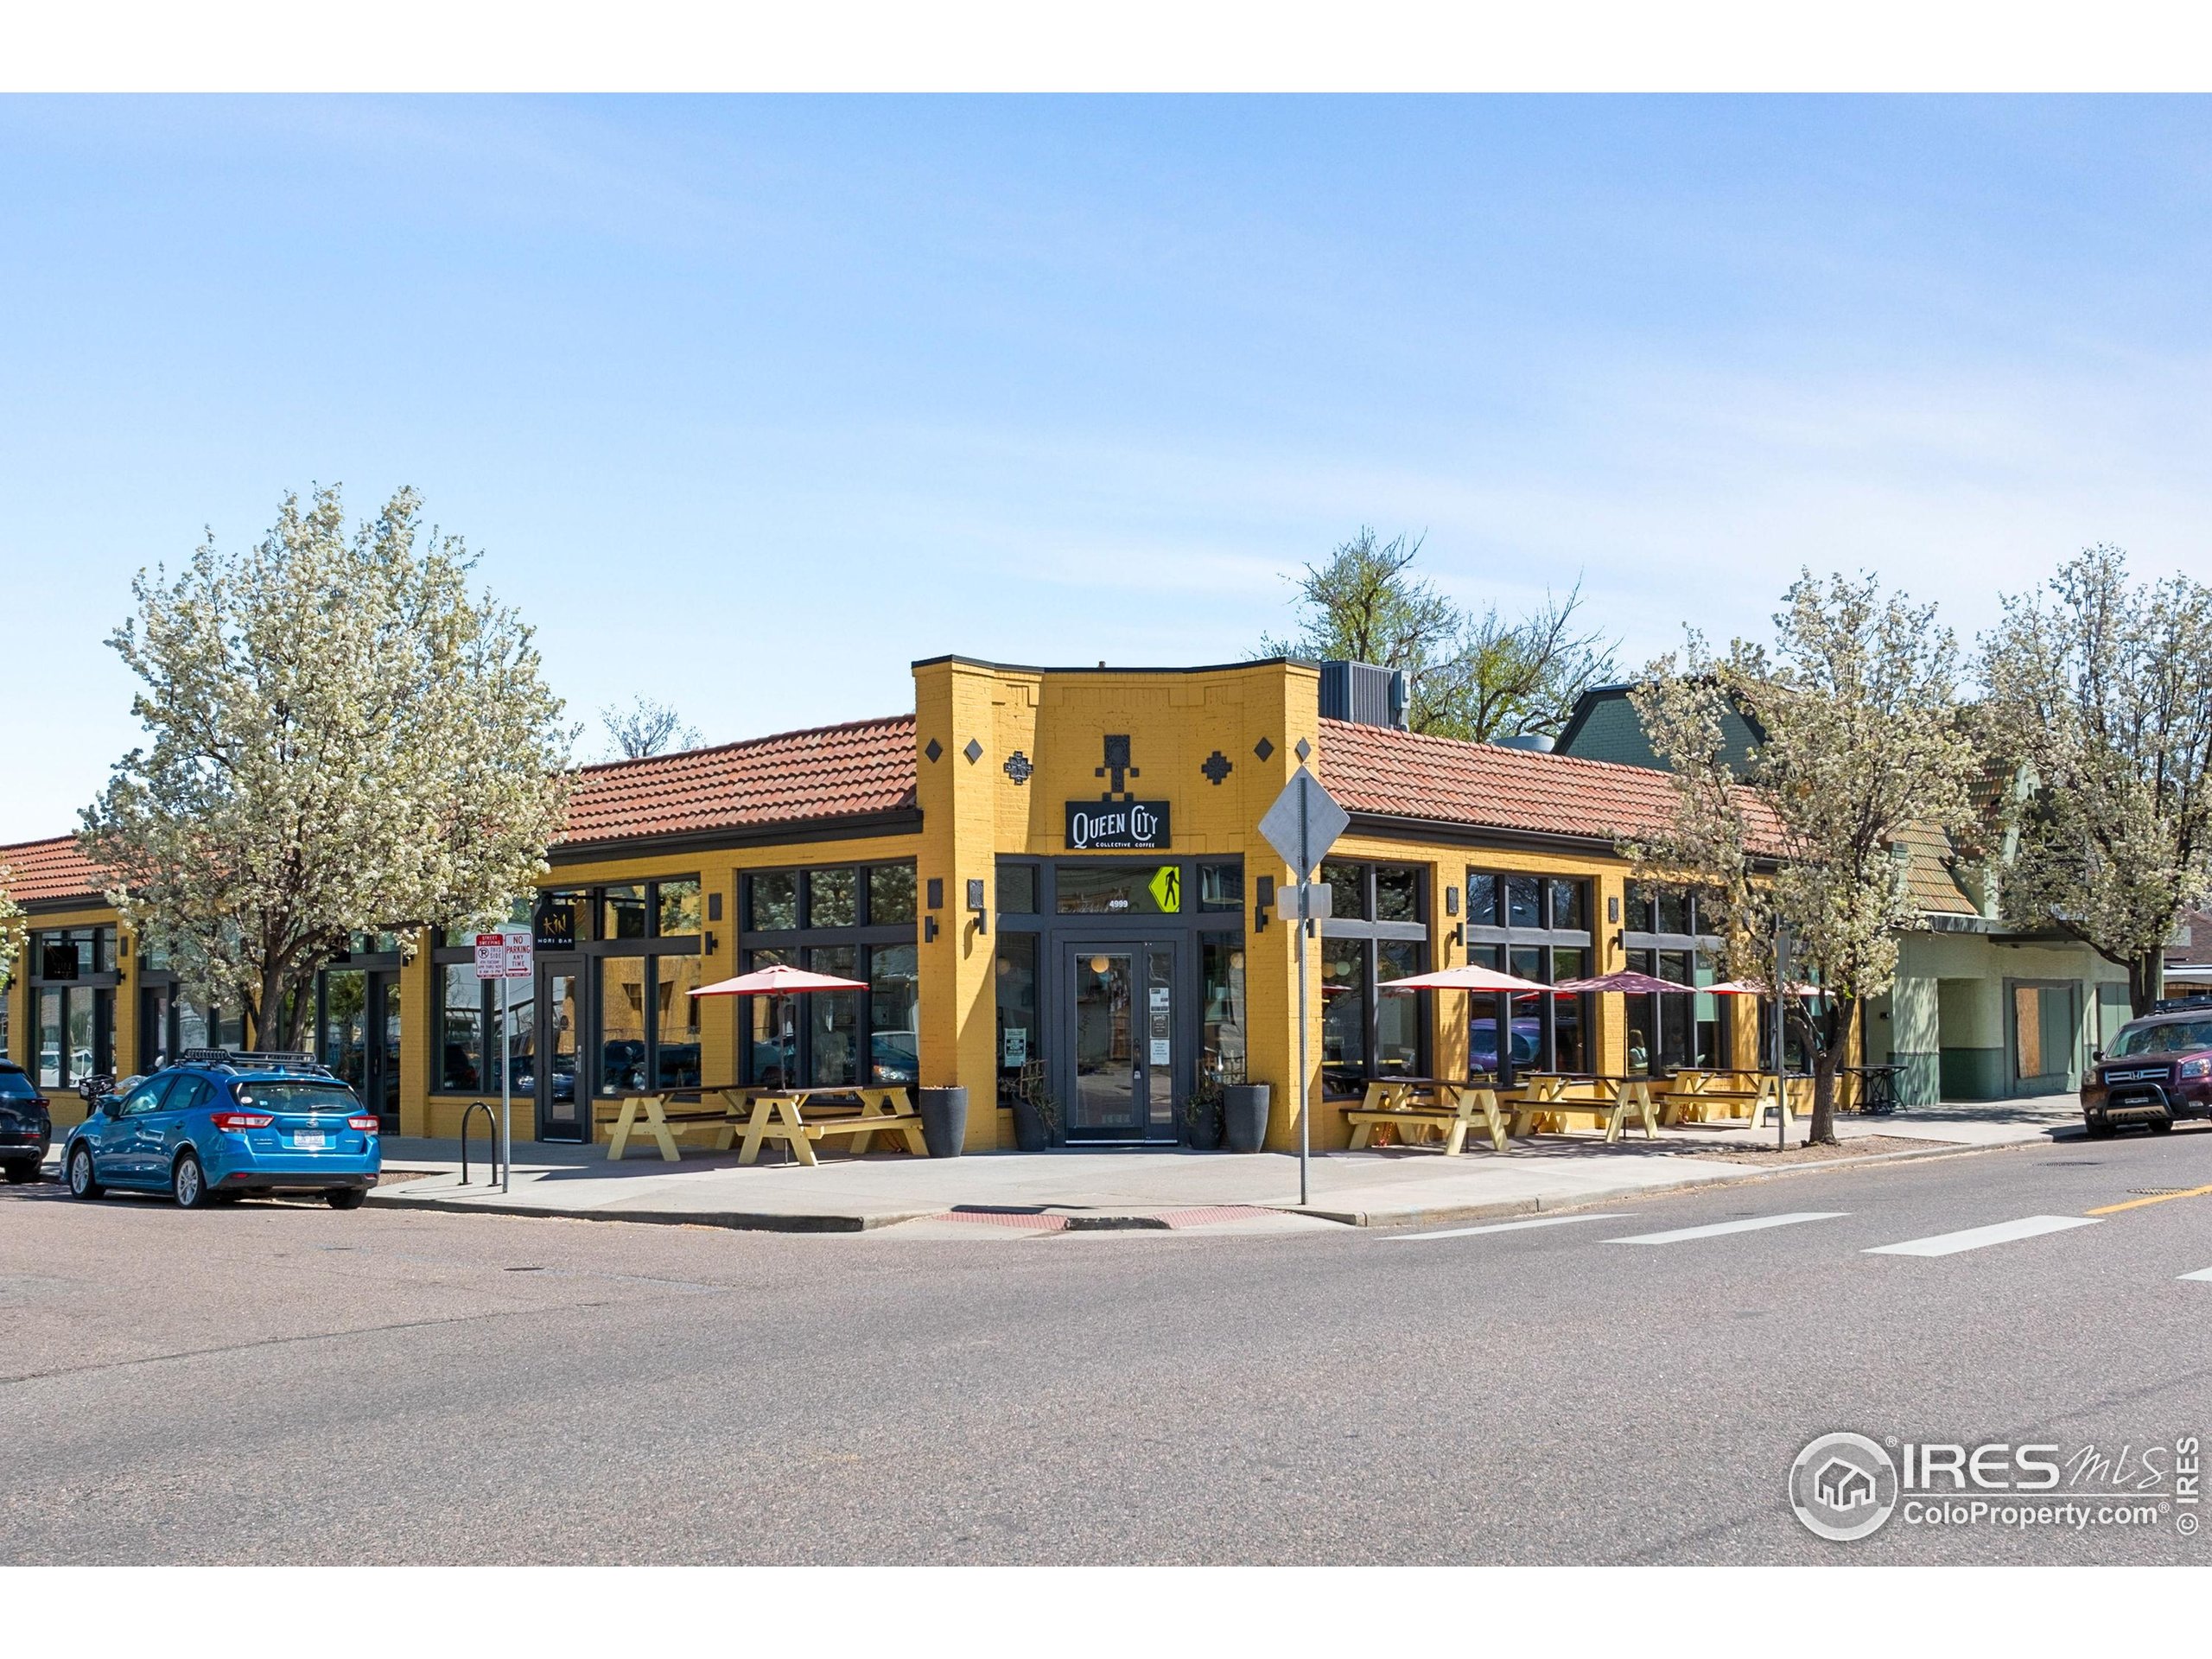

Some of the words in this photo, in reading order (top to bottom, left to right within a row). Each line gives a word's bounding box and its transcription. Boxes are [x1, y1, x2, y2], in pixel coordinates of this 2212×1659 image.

[1072, 812, 1125, 849] QUEEN
[1131, 804, 1159, 842] CITY
[1109, 899, 1128, 908] 4999
[512, 935, 524, 944] NO
[506, 945, 531, 954] PARKING
